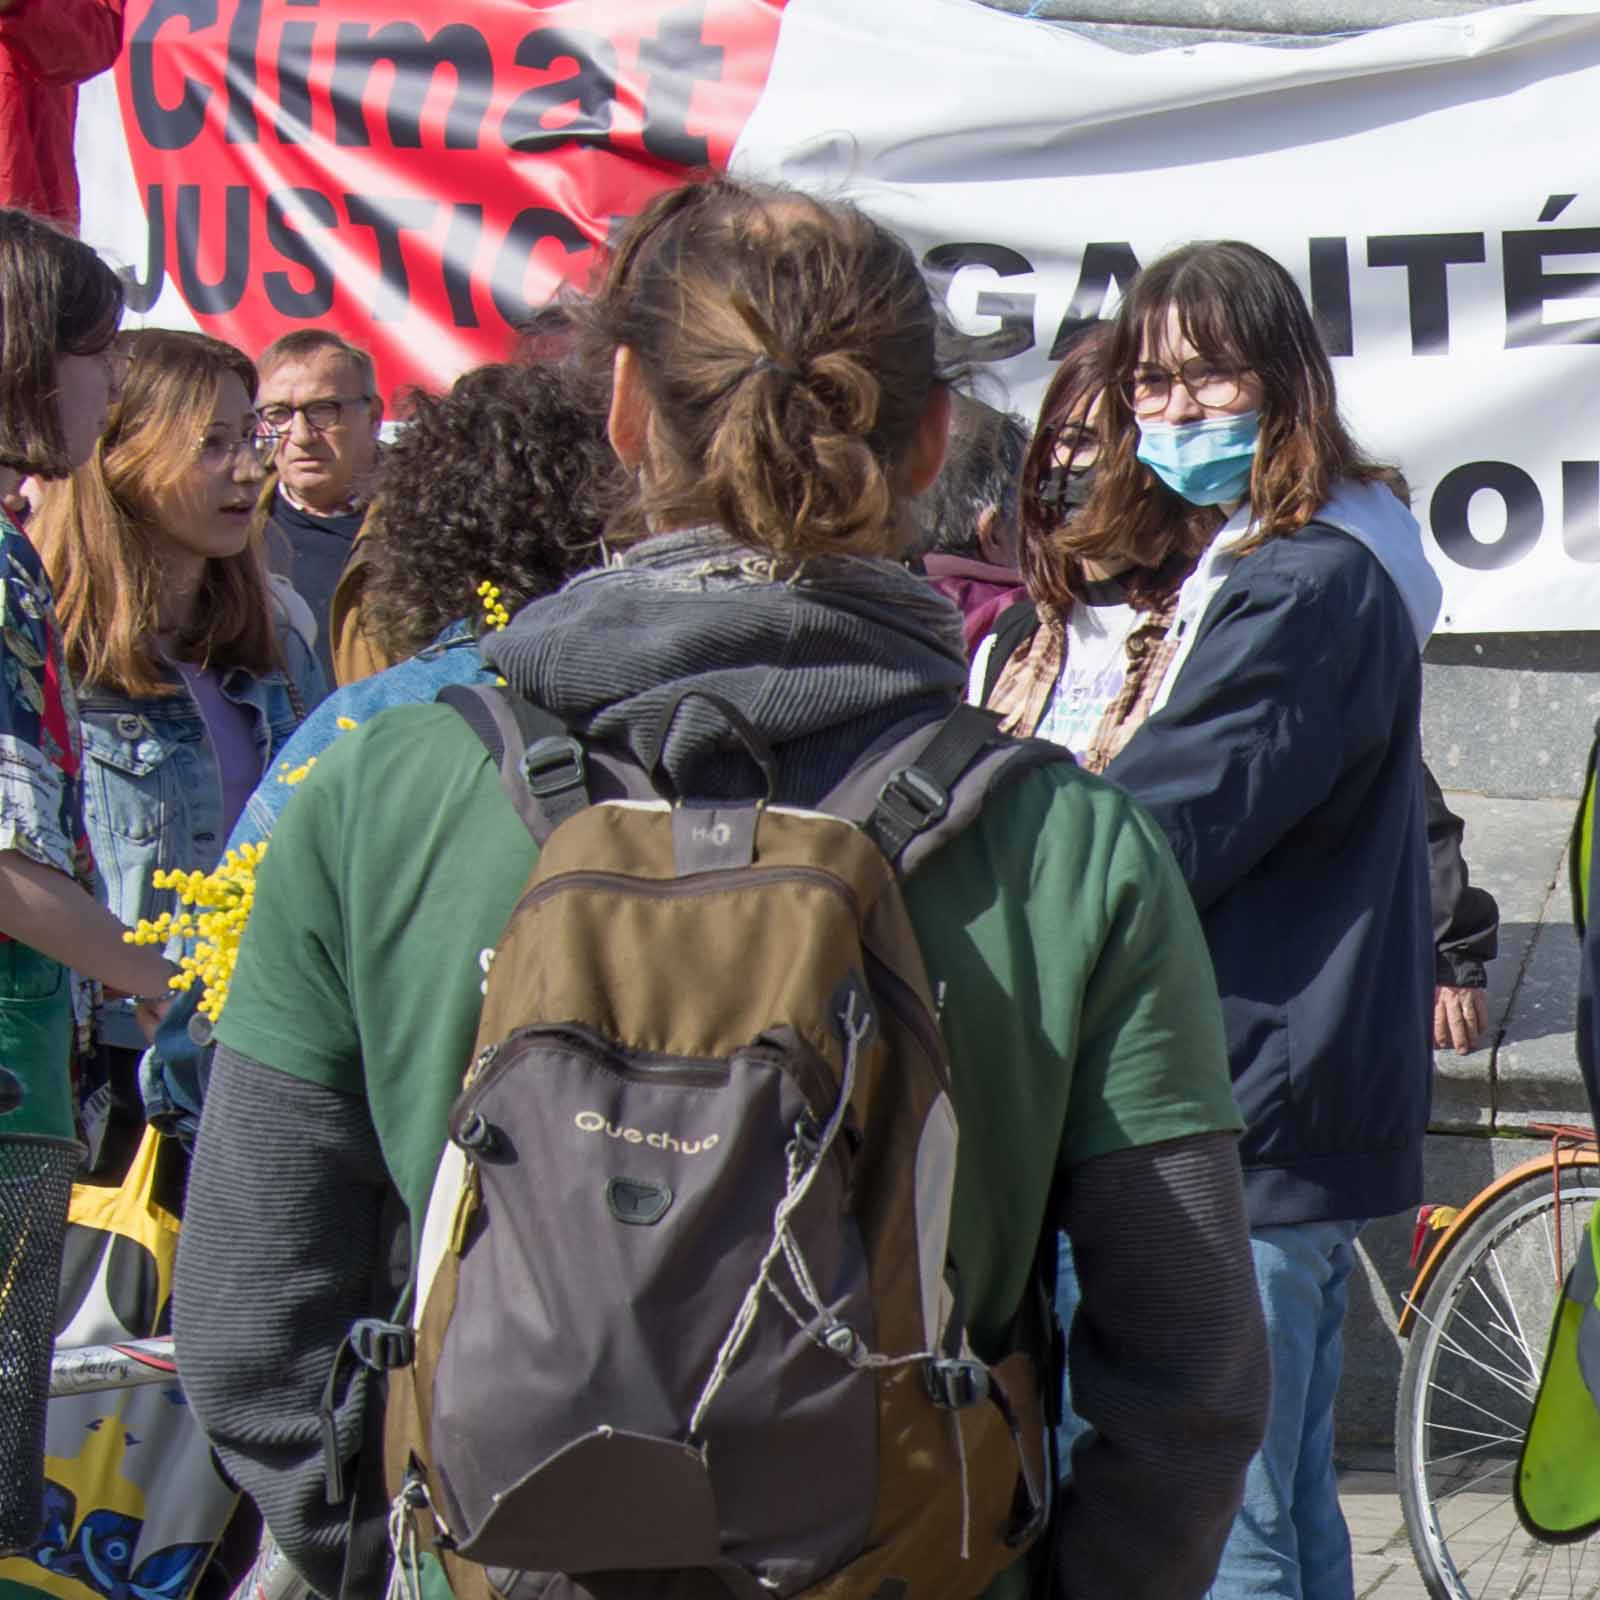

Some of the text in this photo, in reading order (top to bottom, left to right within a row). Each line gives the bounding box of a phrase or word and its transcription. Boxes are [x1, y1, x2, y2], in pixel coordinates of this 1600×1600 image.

[130, 0, 726, 167] Climat
[118, 183, 640, 331] JUSTIC
[574, 1110, 721, 1155] Quechua
